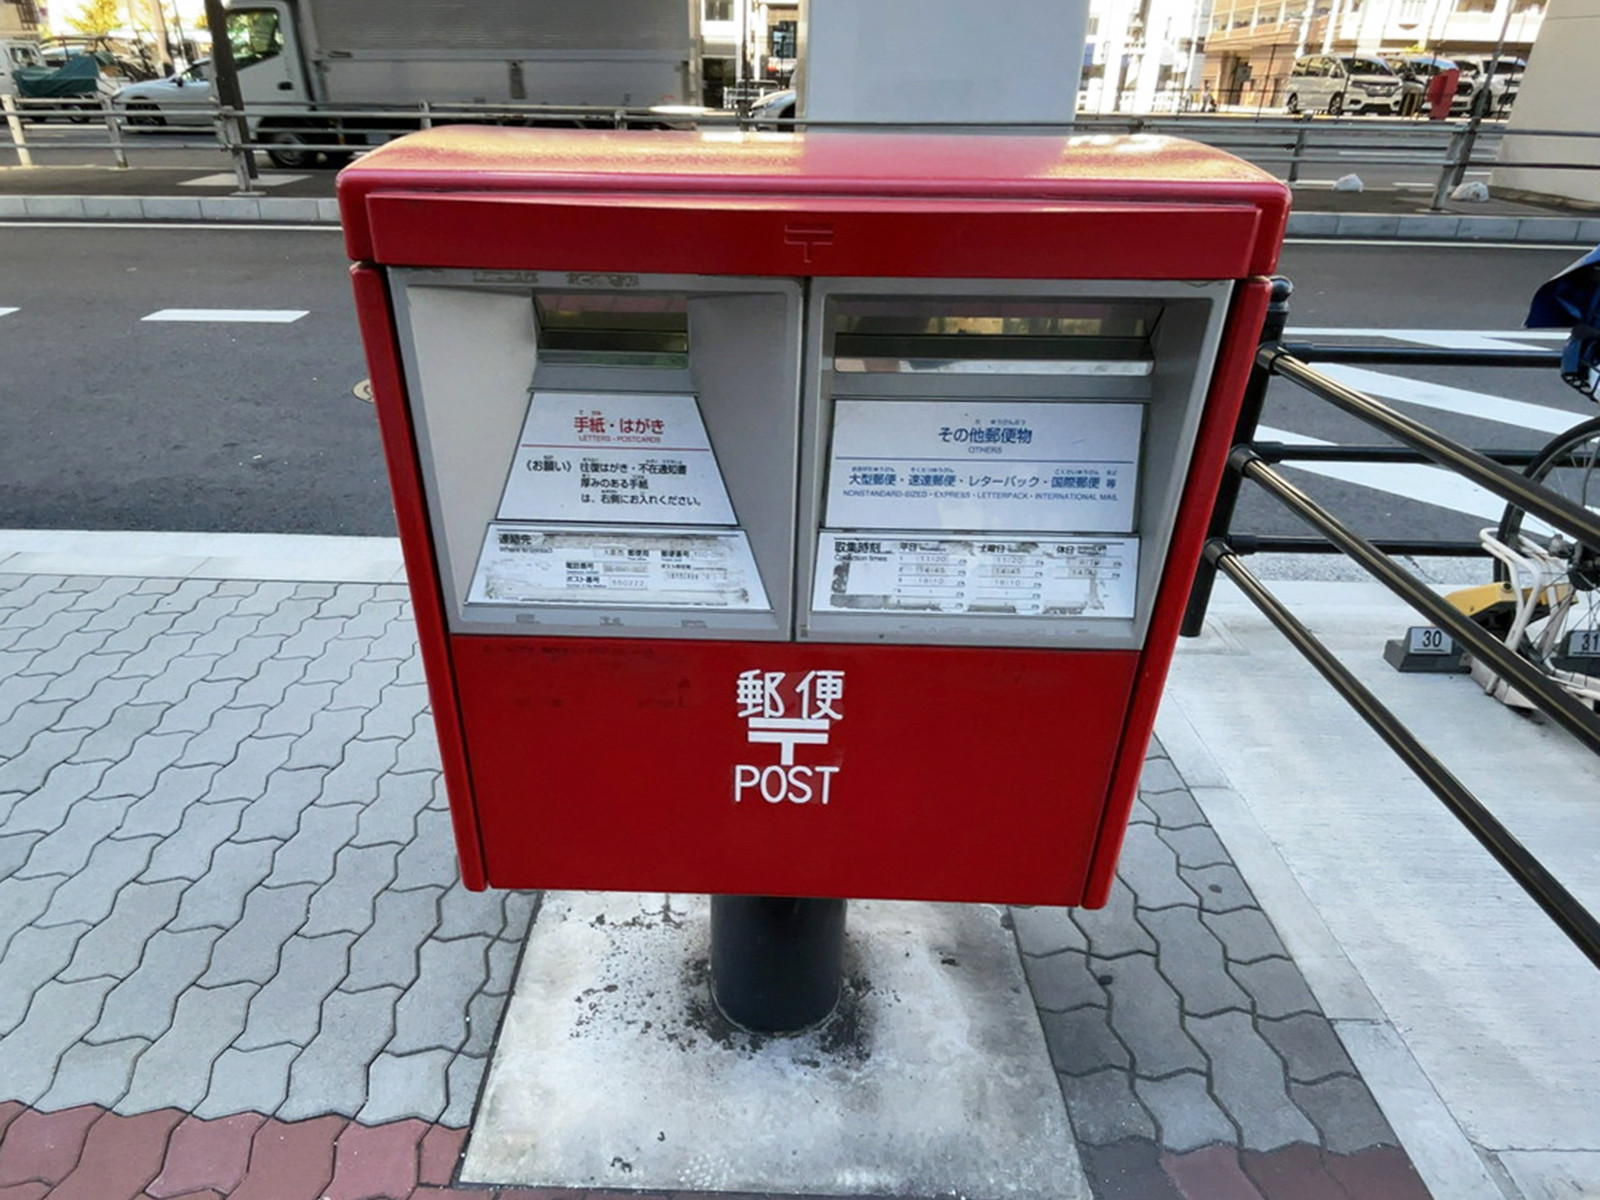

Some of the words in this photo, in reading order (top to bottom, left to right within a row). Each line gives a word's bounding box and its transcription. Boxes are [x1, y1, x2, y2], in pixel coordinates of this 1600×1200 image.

[574, 416, 665, 435] 手紙・はがき
[938, 427, 1033, 444] その他郵便物
[968, 446, 1003, 454] OTHERS
[1422, 630, 1442, 648] 30
[1582, 633, 1599, 651] 31
[736, 669, 846, 721] 郵便
[734, 765, 840, 805] POST
